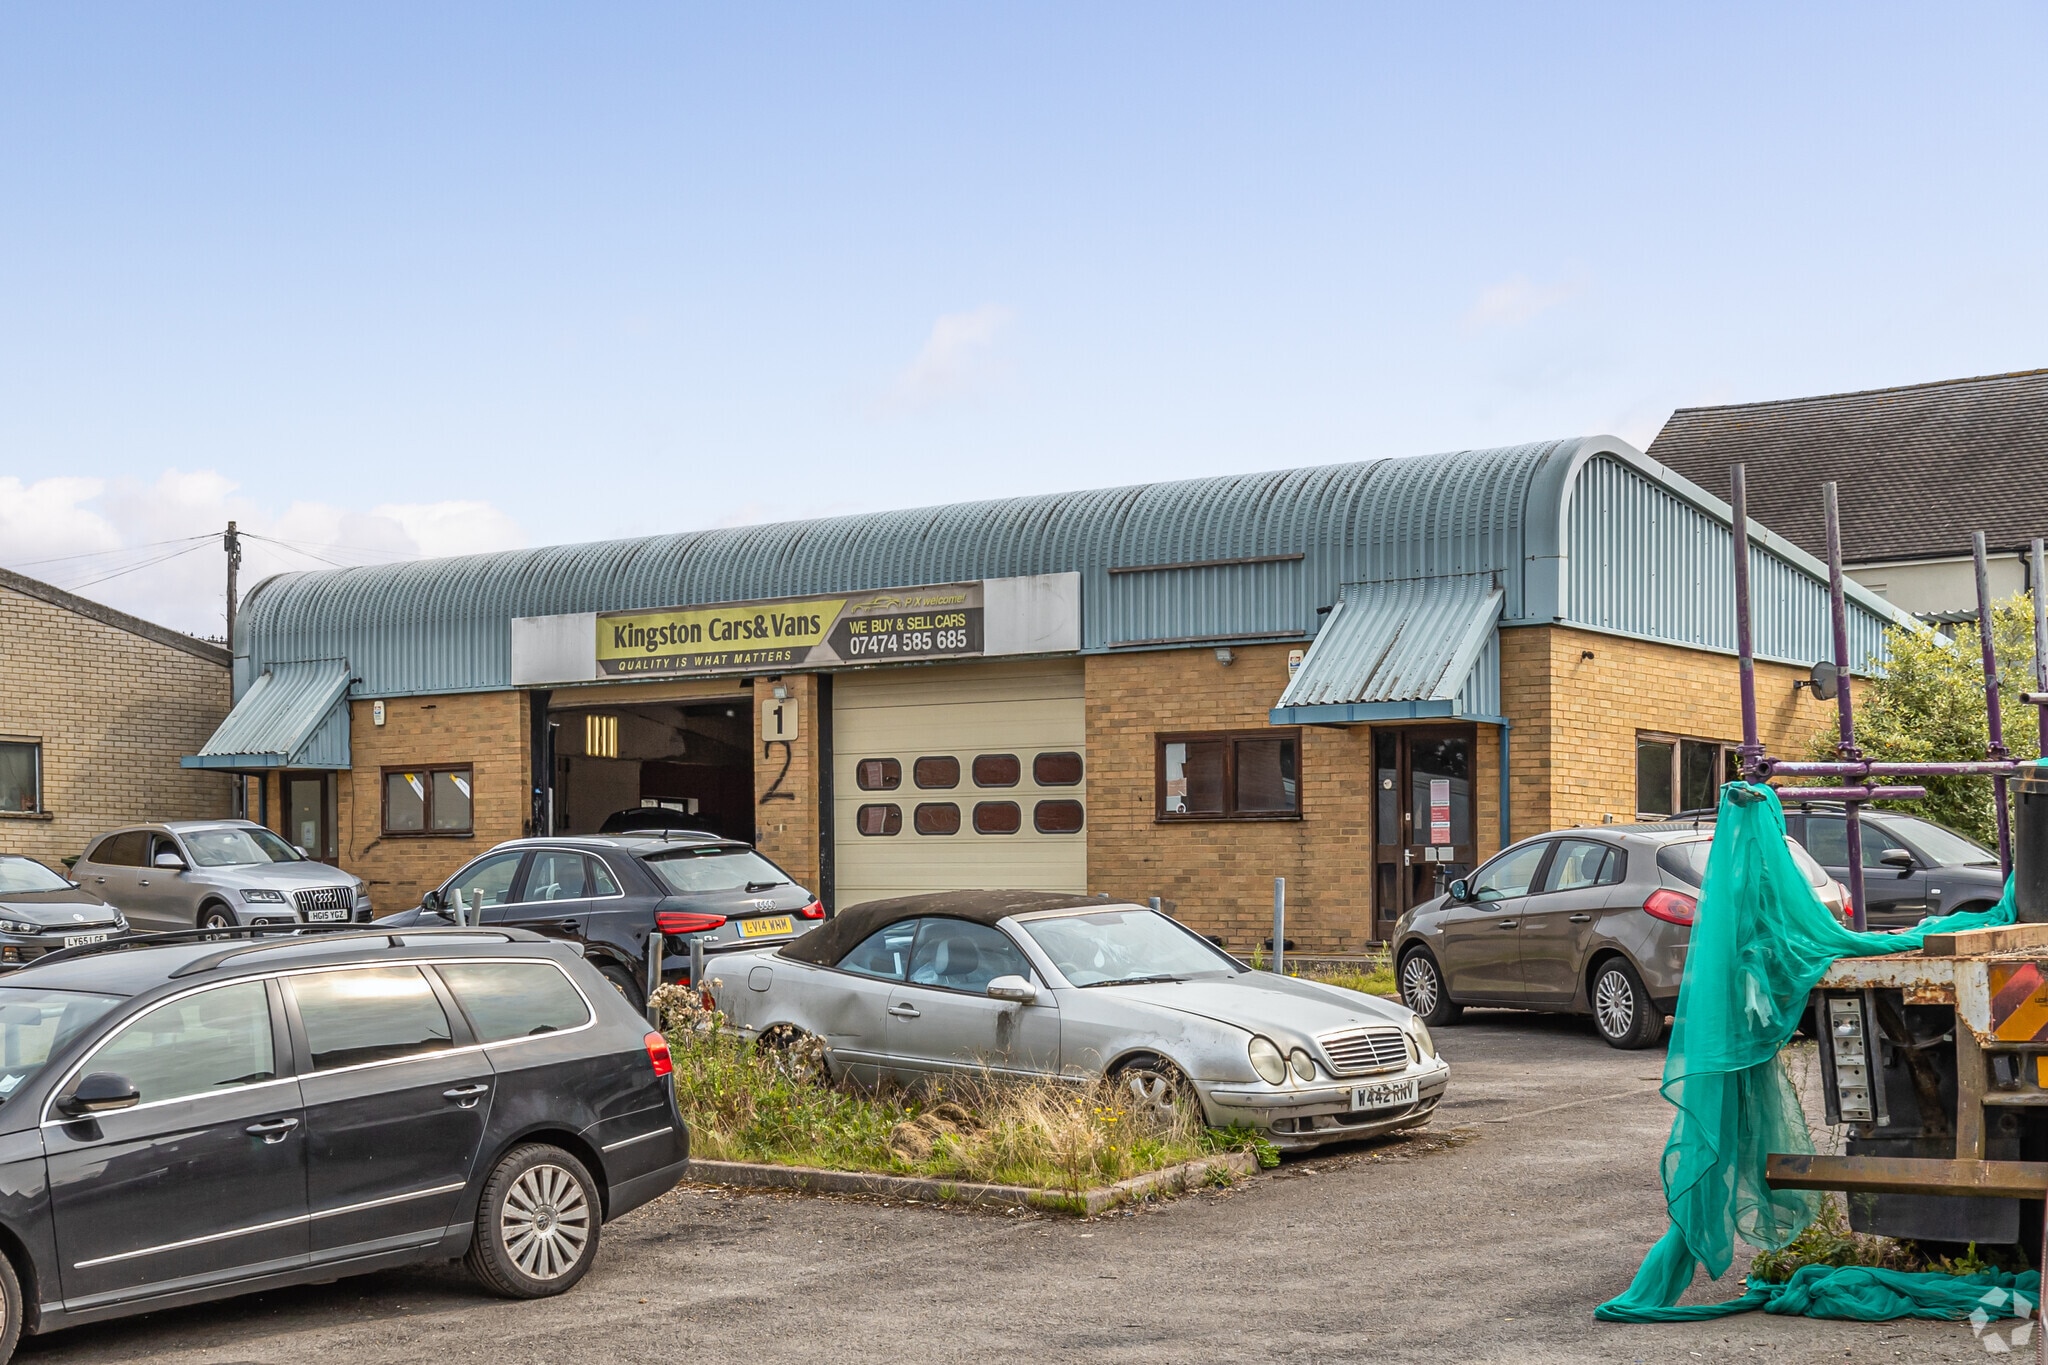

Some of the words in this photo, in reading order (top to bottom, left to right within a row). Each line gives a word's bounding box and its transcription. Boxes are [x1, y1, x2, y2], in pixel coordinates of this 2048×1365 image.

[923, 593, 966, 606] welcome!
[849, 621, 867, 634] WE
[871, 619, 893, 632] BUY
[896, 618, 904, 631] &
[907, 616, 934, 630] SELL
[935, 613, 966, 628] CARS
[614, 623, 701, 652] Kingston
[850, 634, 898, 655] 07474
[902, 632, 932, 651] 585
[936, 629, 967, 649] 685
[618, 658, 669, 671] QUALITY
[676, 657, 687, 668] IS
[694, 654, 728, 666] WHAT
[733, 651, 791, 664] MATTERS
[773, 705, 783, 734] 1
[760, 741, 795, 805] 2
[330, 910, 344, 919] YGZ
[745, 920, 767, 933] LV14
[67, 936, 88, 946] LY65
[1358, 1084, 1390, 1107] W442
[1393, 1082, 1413, 1101] RNV
